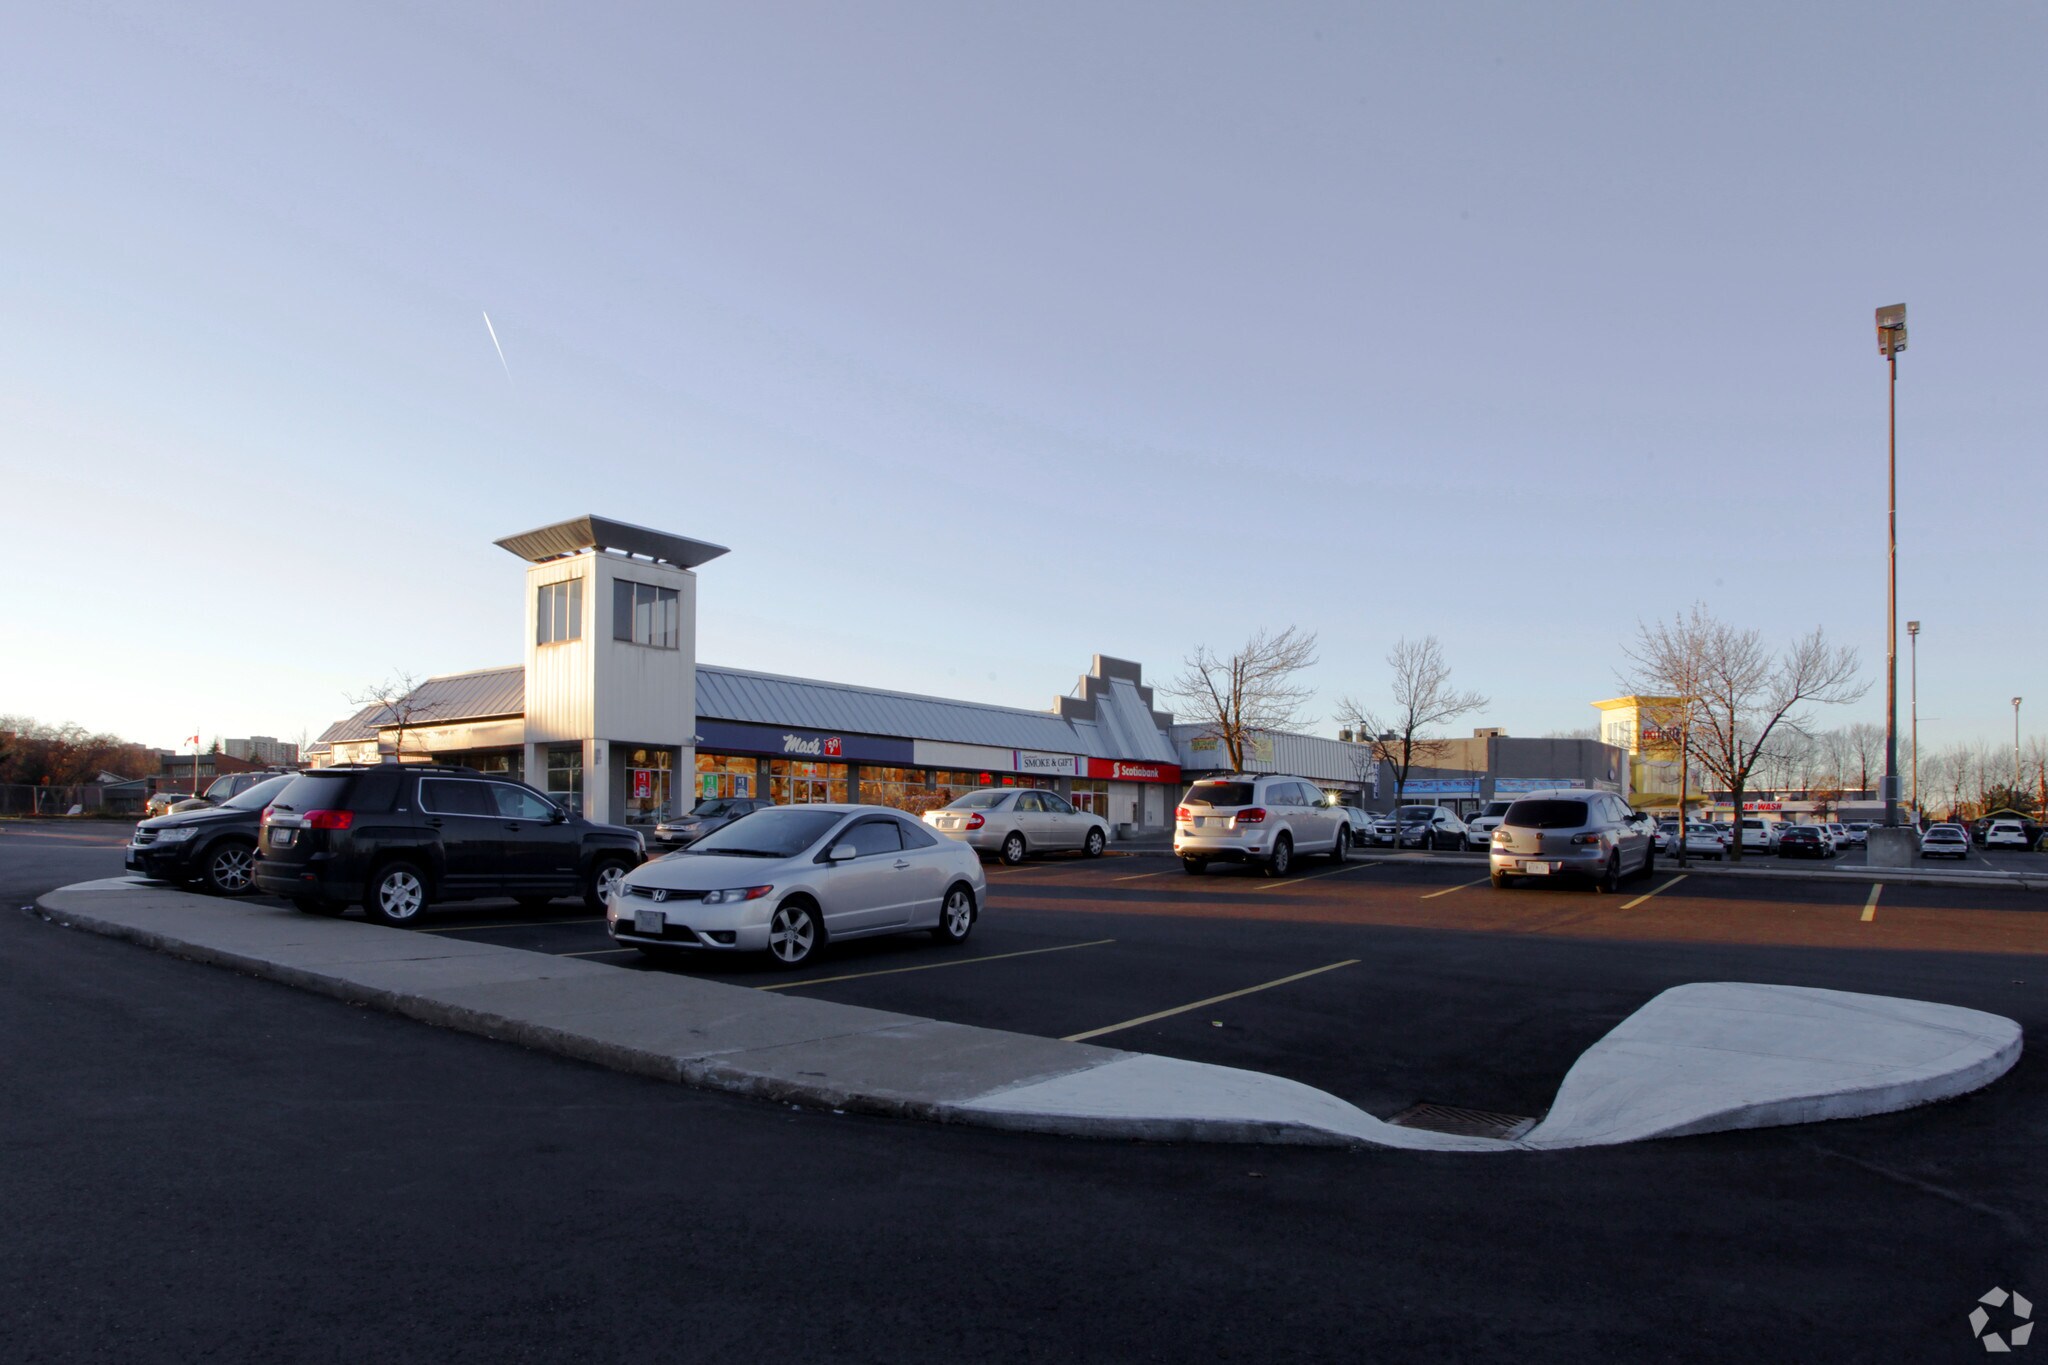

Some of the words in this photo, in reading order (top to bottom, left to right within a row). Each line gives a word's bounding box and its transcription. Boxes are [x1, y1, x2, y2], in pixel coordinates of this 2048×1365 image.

[1024, 758, 1050, 768] SMOKE
[1052, 759, 1056, 767] &
[1058, 758, 1073, 767] GIFT
[1121, 765, 1159, 778] Scotiabank
